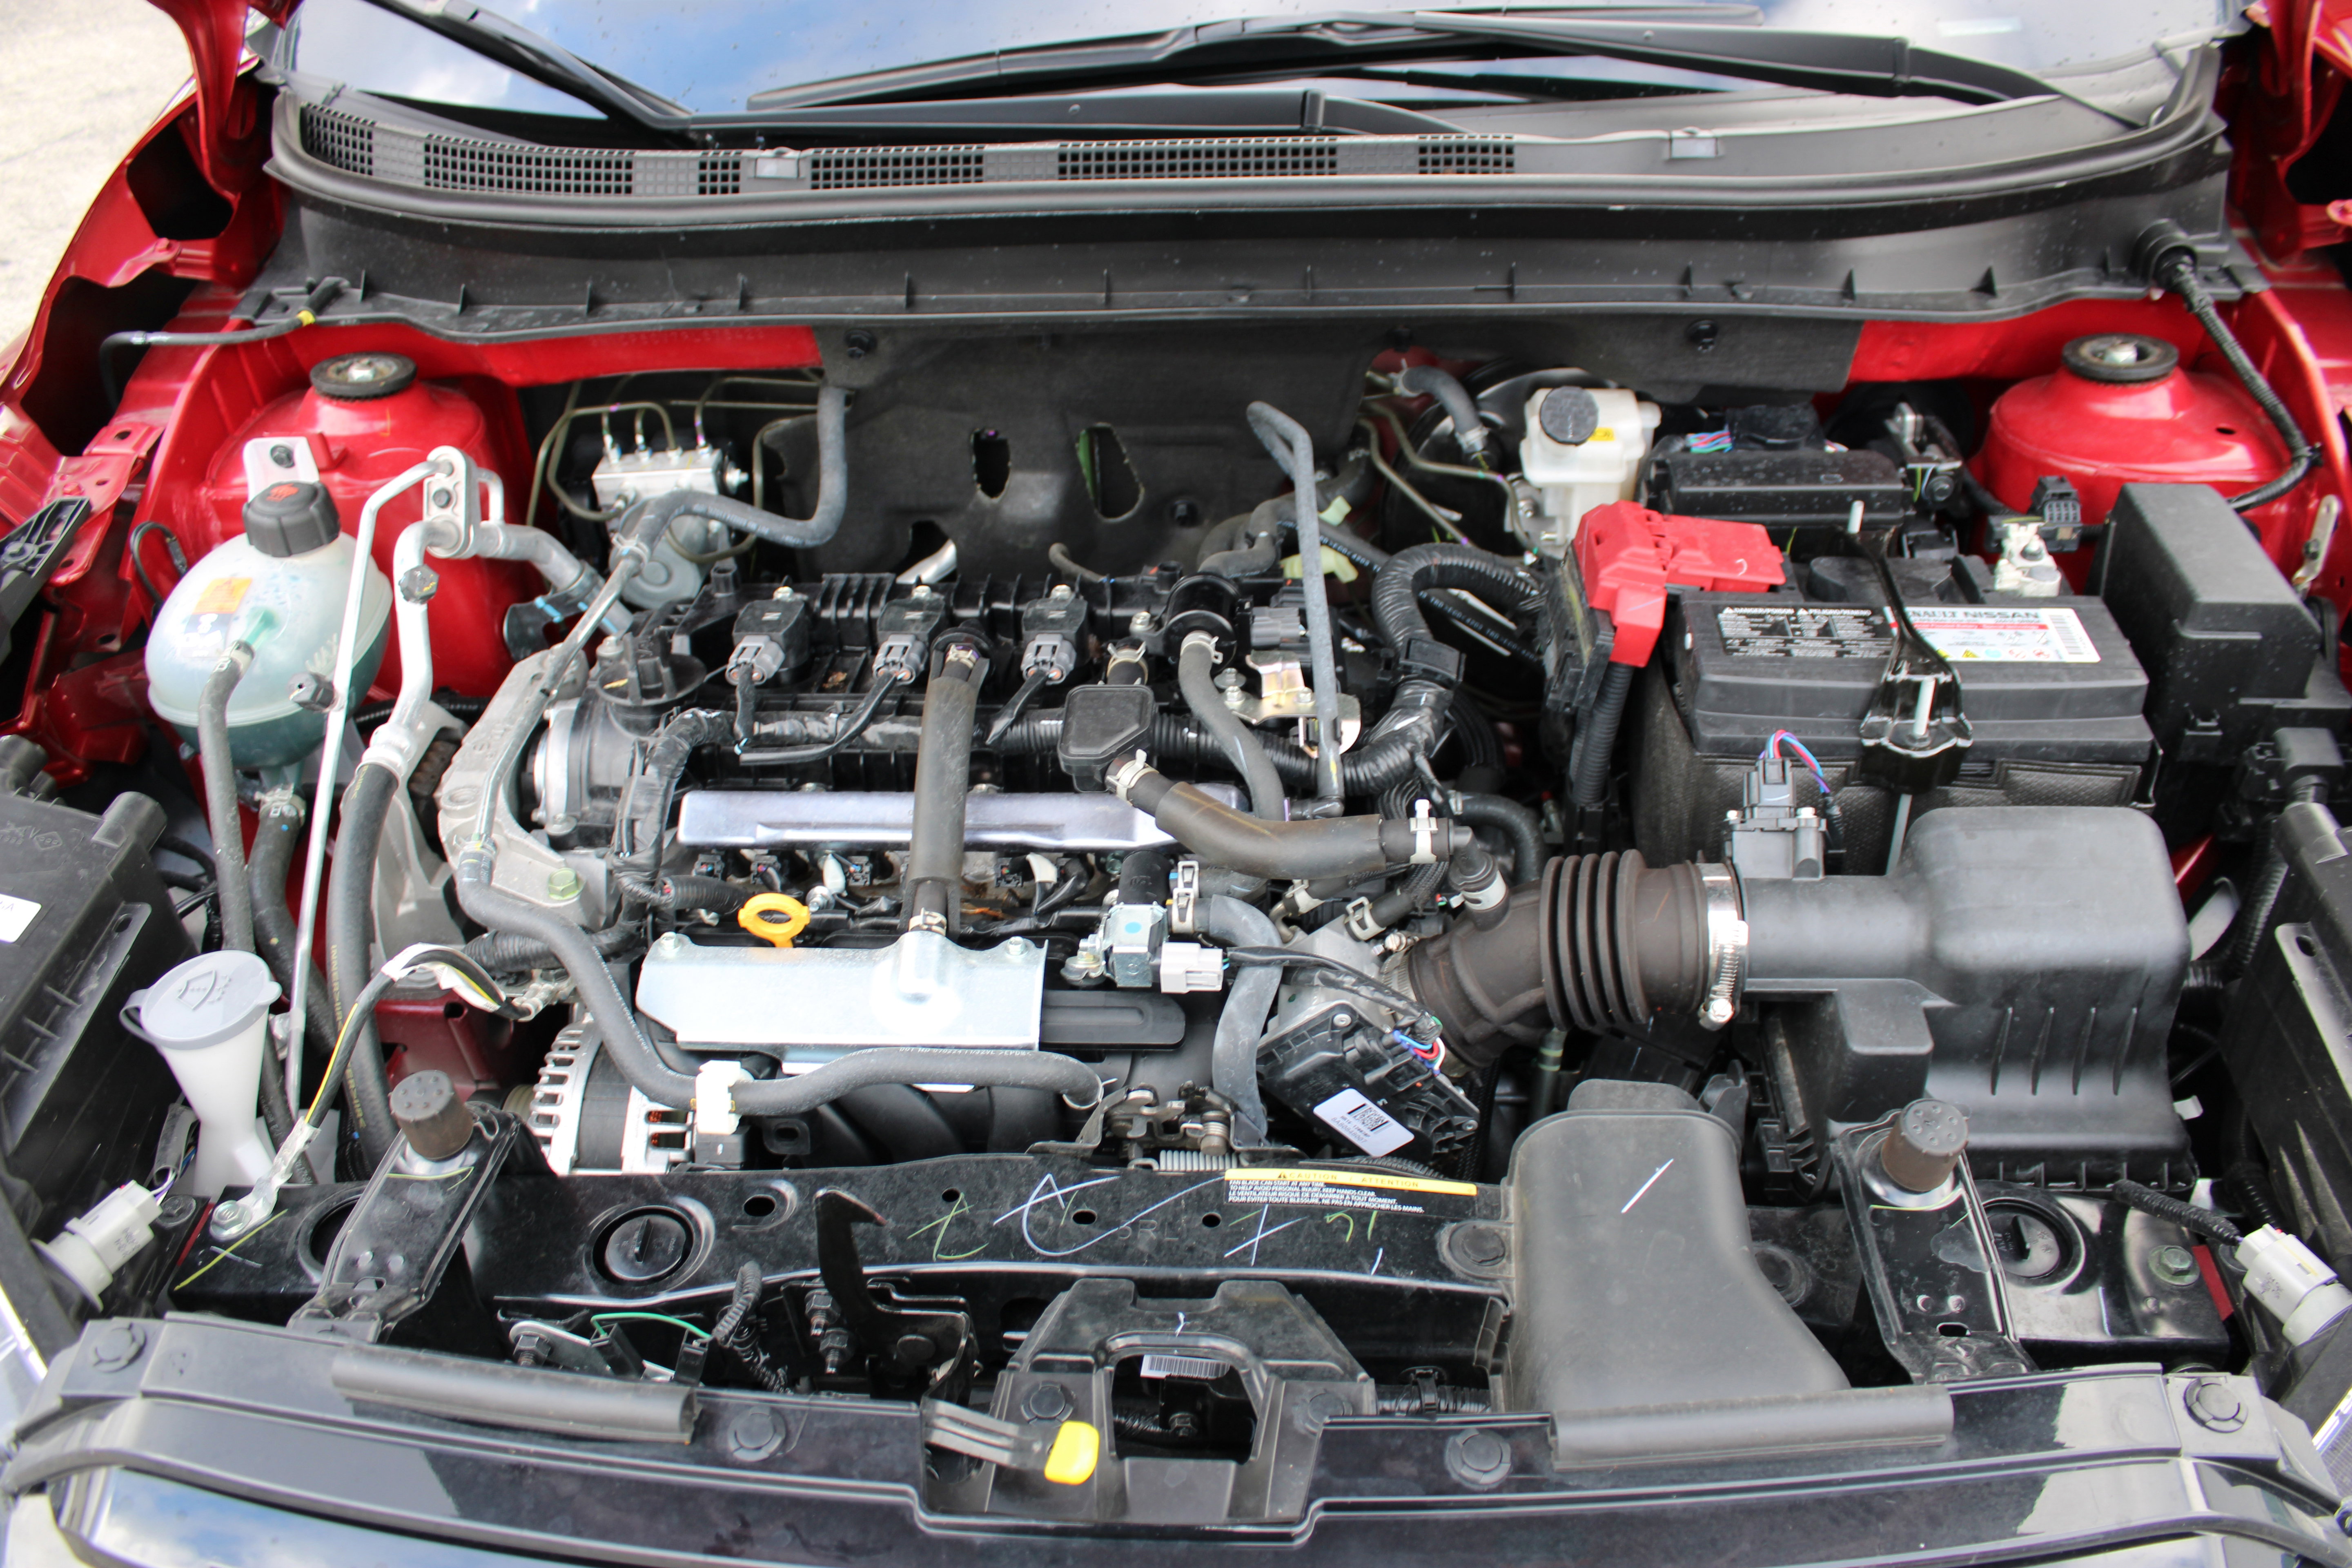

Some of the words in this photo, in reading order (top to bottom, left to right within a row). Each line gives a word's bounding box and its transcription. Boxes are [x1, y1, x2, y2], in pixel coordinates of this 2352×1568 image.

[1361, 1177, 1419, 1187] ATTENTION
[1311, 1192, 1344, 1200] DÉMARRER
[1353, 1201, 1390, 1210] APPROCHER
[1402, 1205, 1425, 1213] MAINS.
